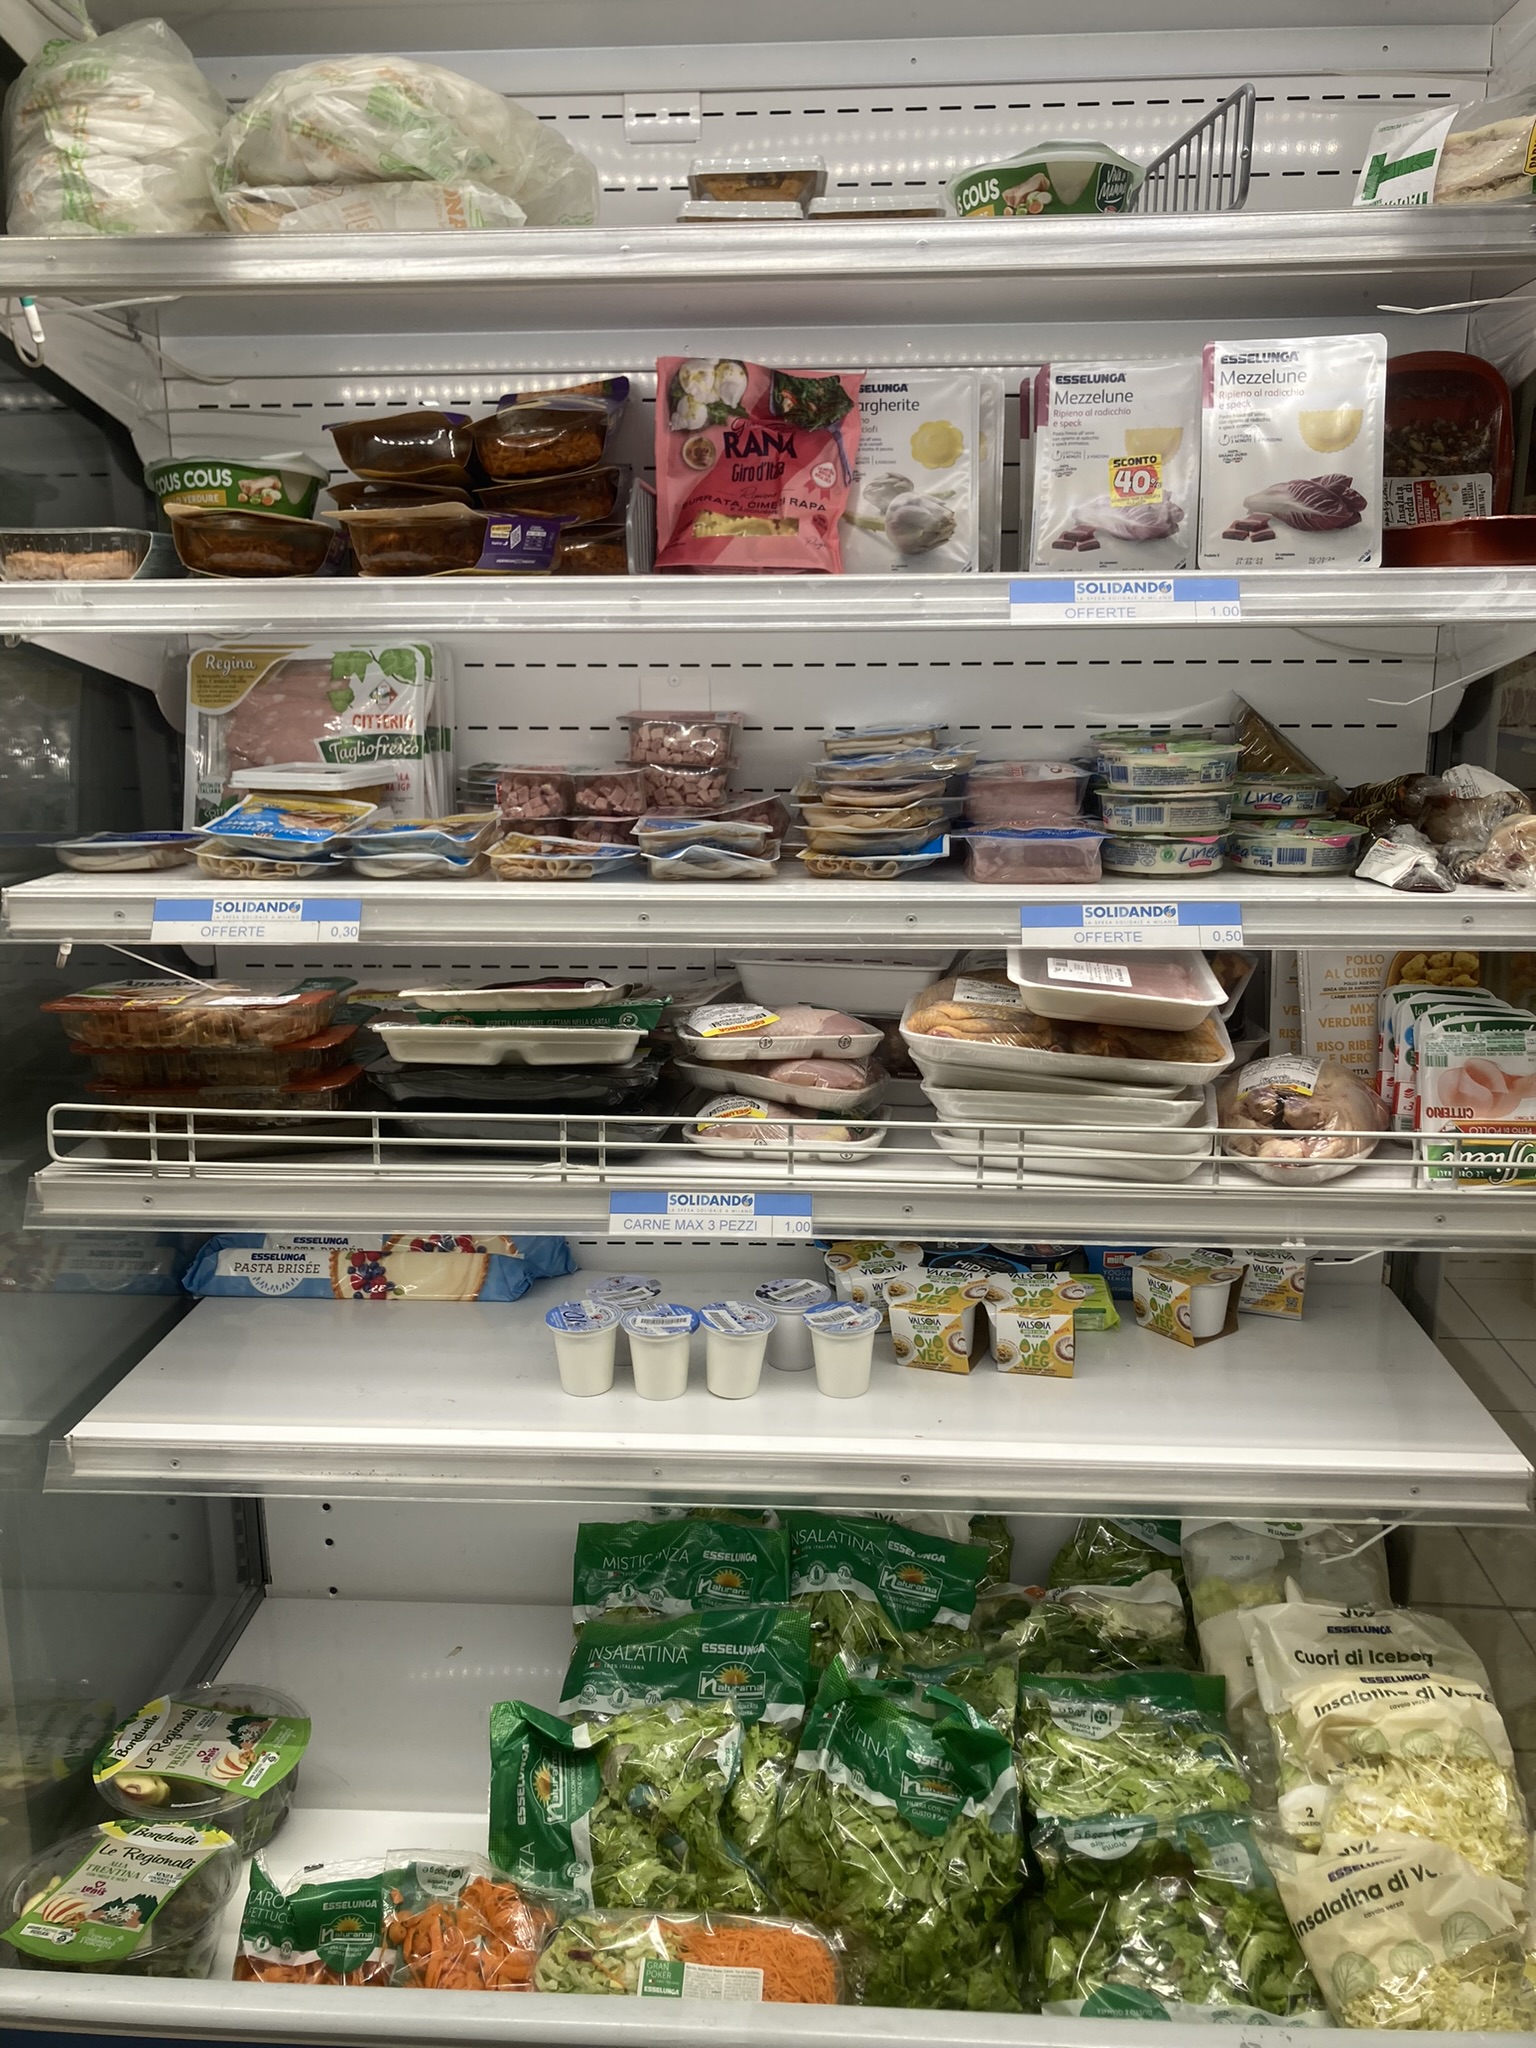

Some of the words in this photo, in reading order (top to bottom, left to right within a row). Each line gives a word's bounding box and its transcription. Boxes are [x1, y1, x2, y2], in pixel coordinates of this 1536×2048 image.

[962, 178, 1000, 209] COUS
[1220, 351, 1299, 364] ESSELUNGA
[1055, 373, 1126, 385] ESSELUNGA
[1220, 369, 1307, 386] Mezzelune
[858, 383, 908, 393] SELUNGA
[1219, 390, 1251, 401] Ripieno
[1254, 389, 1262, 398] al
[1264, 387, 1305, 398] radicchio
[1054, 389, 1134, 406] Mezzelune
[858, 397, 919, 416] argherite
[1226, 400, 1252, 411] speck
[1053, 409, 1083, 419] Ripieno
[1085, 408, 1093, 417] al
[1094, 407, 1131, 417] radicchio
[1060, 418, 1082, 428] speck
[723, 431, 798, 459] RANA
[1113, 455, 1157, 467] SCONTO
[183, 468, 233, 488] COUS
[732, 464, 755, 482] Giro
[1114, 470, 1161, 495] 40%
[1404, 483, 1412, 493] di
[182, 492, 219, 504] VERDURE
[747, 500, 779, 510] CIME
[789, 497, 827, 512] RAPA
[1395, 486, 1406, 524] Insalata
[1423, 497, 1432, 523] ERDURE
[1076, 582, 1172, 594] SOLIDANDO
[1065, 606, 1136, 619] OFFERTE
[1209, 605, 1239, 617] 1.00
[206, 654, 256, 676] Regina
[1244, 790, 1294, 807] Linea
[1178, 845, 1221, 863] Linea
[215, 901, 301, 913] SOLIDANDO
[1085, 905, 1176, 918] SOLIDANDO
[201, 925, 265, 938] OFFERTE
[330, 925, 358, 938] 0,30
[1074, 931, 1142, 944] OFFERTE
[1212, 930, 1242, 943] 0,50
[1346, 954, 1385, 965] POLLO
[1325, 968, 1341, 979] AL
[1344, 967, 1382, 979] CURRY
[1350, 1003, 1376, 1015] MIX
[1318, 1016, 1375, 1029] VERDURE
[1316, 1041, 1344, 1052] RISO
[1348, 1040, 1374, 1051] RIBE
[1340, 1053, 1374, 1065] NERO
[1403, 1101, 1415, 1111] x3
[1426, 1106, 1473, 1119] CITTERIO
[669, 1194, 753, 1207] SOLIDANDO
[623, 1218, 671, 1230] CARNE
[674, 1219, 705, 1231] MAX
[708, 1219, 716, 1231] 3
[719, 1219, 758, 1231] PEZZI
[784, 1221, 811, 1233] 1,00
[293, 1236, 349, 1245] ESSELUNGA
[251, 1252, 306, 1261] ESSELUNGA
[234, 1262, 274, 1274] PASTA
[277, 1260, 321, 1274] BRISÉE
[859, 1264, 908, 1276] VALSOIA
[926, 1268, 973, 1279] VALSOIA
[1252, 1263, 1284, 1275] VALSOIA
[1008, 1272, 1058, 1280] VALSOIA
[1147, 1277, 1173, 1294] VALSOIA
[916, 1292, 951, 1305] VEG
[1014, 1297, 1053, 1308] VEG
[908, 1315, 942, 1326] VALSOIA
[1016, 1319, 1052, 1330] VALSOIA
[1151, 1311, 1174, 1331] VEG
[917, 1348, 945, 1362] VEG
[1021, 1353, 1050, 1368] VEG
[703, 1550, 758, 1563] ESSELUNGA
[1327, 1625, 1393, 1635] ESSELUNGA
[587, 1644, 689, 1665] INSALATINA
[1294, 1649, 1339, 1666] Cuori
[1345, 1649, 1364, 1666] di
[1359, 1673, 1431, 1685] ESSELUNGA
[1416, 1685, 1435, 1700] di
[114, 1713, 161, 1759] Bonduelle
[135, 1751, 156, 1770] Le
[147, 1707, 199, 1757] Regionali
[165, 1733, 203, 1770] TRENTINA
[517, 1743, 530, 1826] ESSELUNGA
[1305, 1807, 1315, 1818] 2
[132, 1826, 200, 1847] Bonduelle
[98, 1843, 118, 1857] Le
[122, 1845, 198, 1871] Regionali
[108, 1860, 128, 1870] ALLA
[85, 1863, 141, 1881] TRENTINA
[323, 1899, 378, 1911] ESSELUNGA
[1291, 1881, 1384, 1939] Insalatina
[1388, 1868, 1410, 1894] di
[1385, 1900, 1405, 1912] verza
[646, 1961, 663, 1972] GRAN
[646, 1969, 673, 1980] POKER
[643, 1986, 680, 1996] ESSELUNGA
